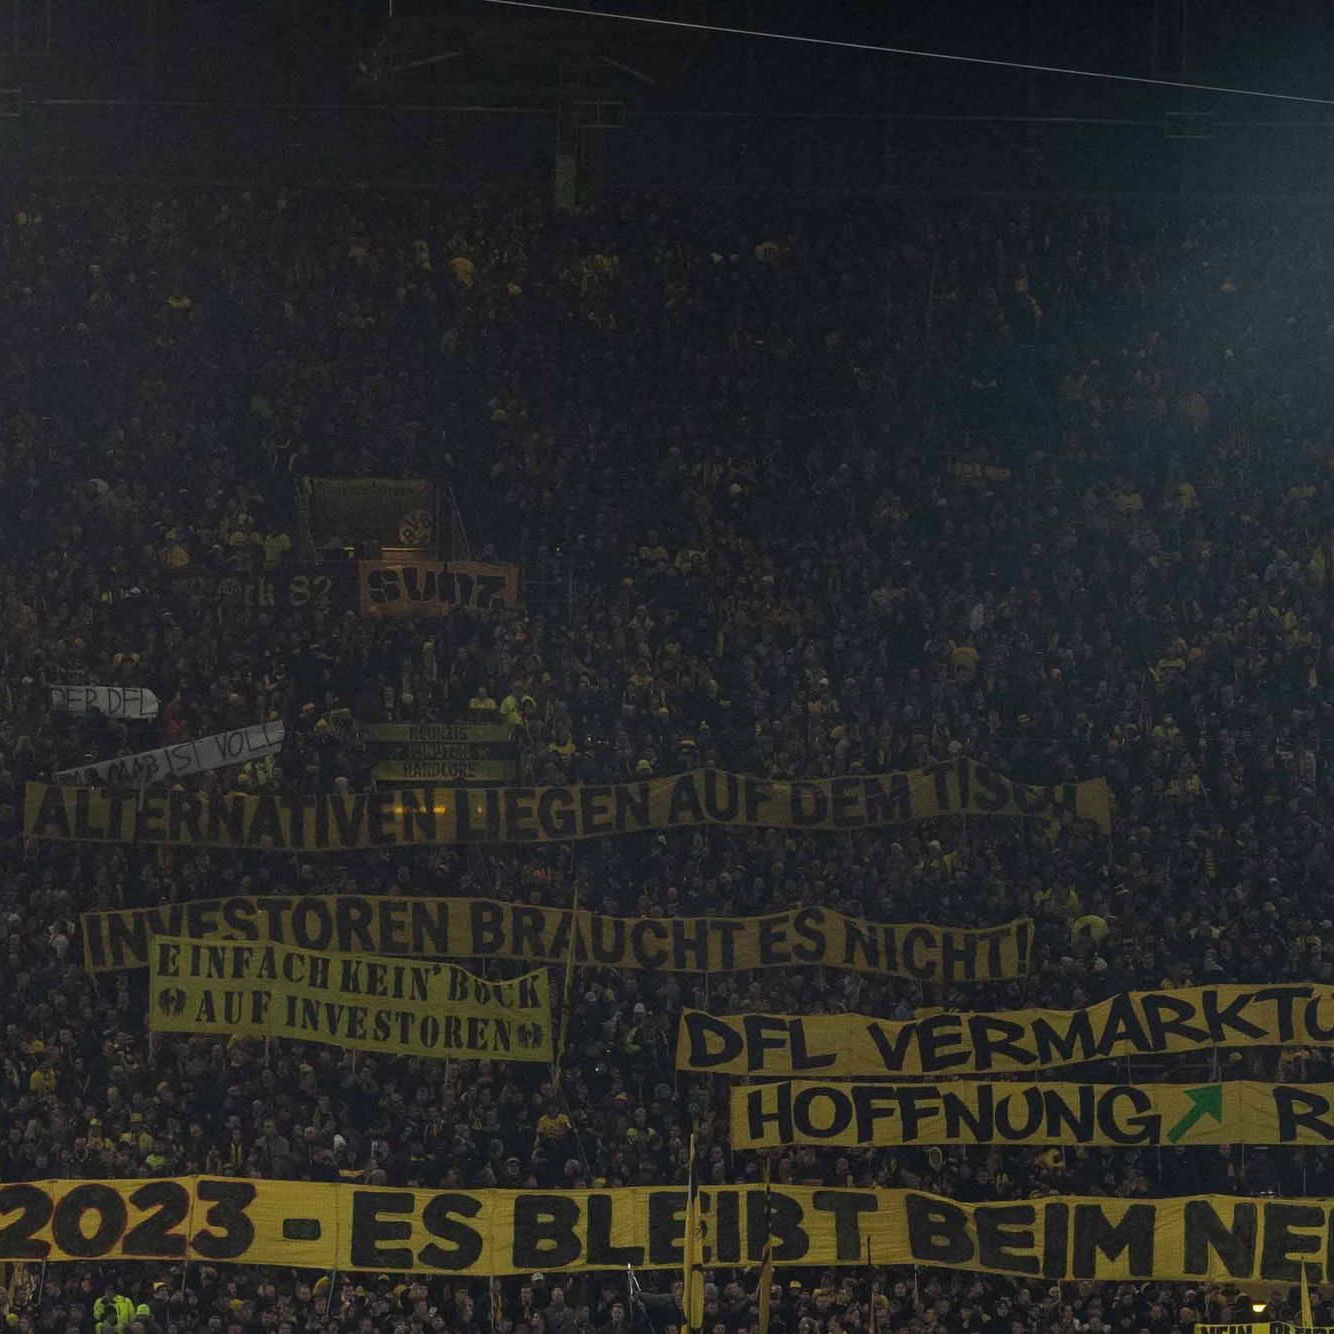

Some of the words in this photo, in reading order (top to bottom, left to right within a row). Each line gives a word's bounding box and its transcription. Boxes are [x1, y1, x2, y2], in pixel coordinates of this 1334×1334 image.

[218, 718, 288, 758] VOLL
[31, 786, 437, 849] ALTERNATIVEN
[455, 782, 651, 843] LIEGEN
[667, 771, 775, 825] AUF
[789, 772, 913, 827] DEM
[83, 897, 451, 968] INVESTOREN
[470, 900, 745, 971] BRAUCHT
[760, 906, 827, 965] ES
[845, 919, 1033, 982] NICHT!
[157, 943, 330, 990] EINFACH
[448, 965, 542, 1009] BOCK
[195, 990, 271, 1024] AUF
[285, 996, 512, 1052] INVESTOREN
[684, 1012, 836, 1071] DFL
[747, 1082, 1162, 1145] HOFFNUNG
[352, 1190, 483, 1268] ES
[513, 1190, 878, 1268] BLEIBT
[905, 1193, 1157, 1280] BEIM
